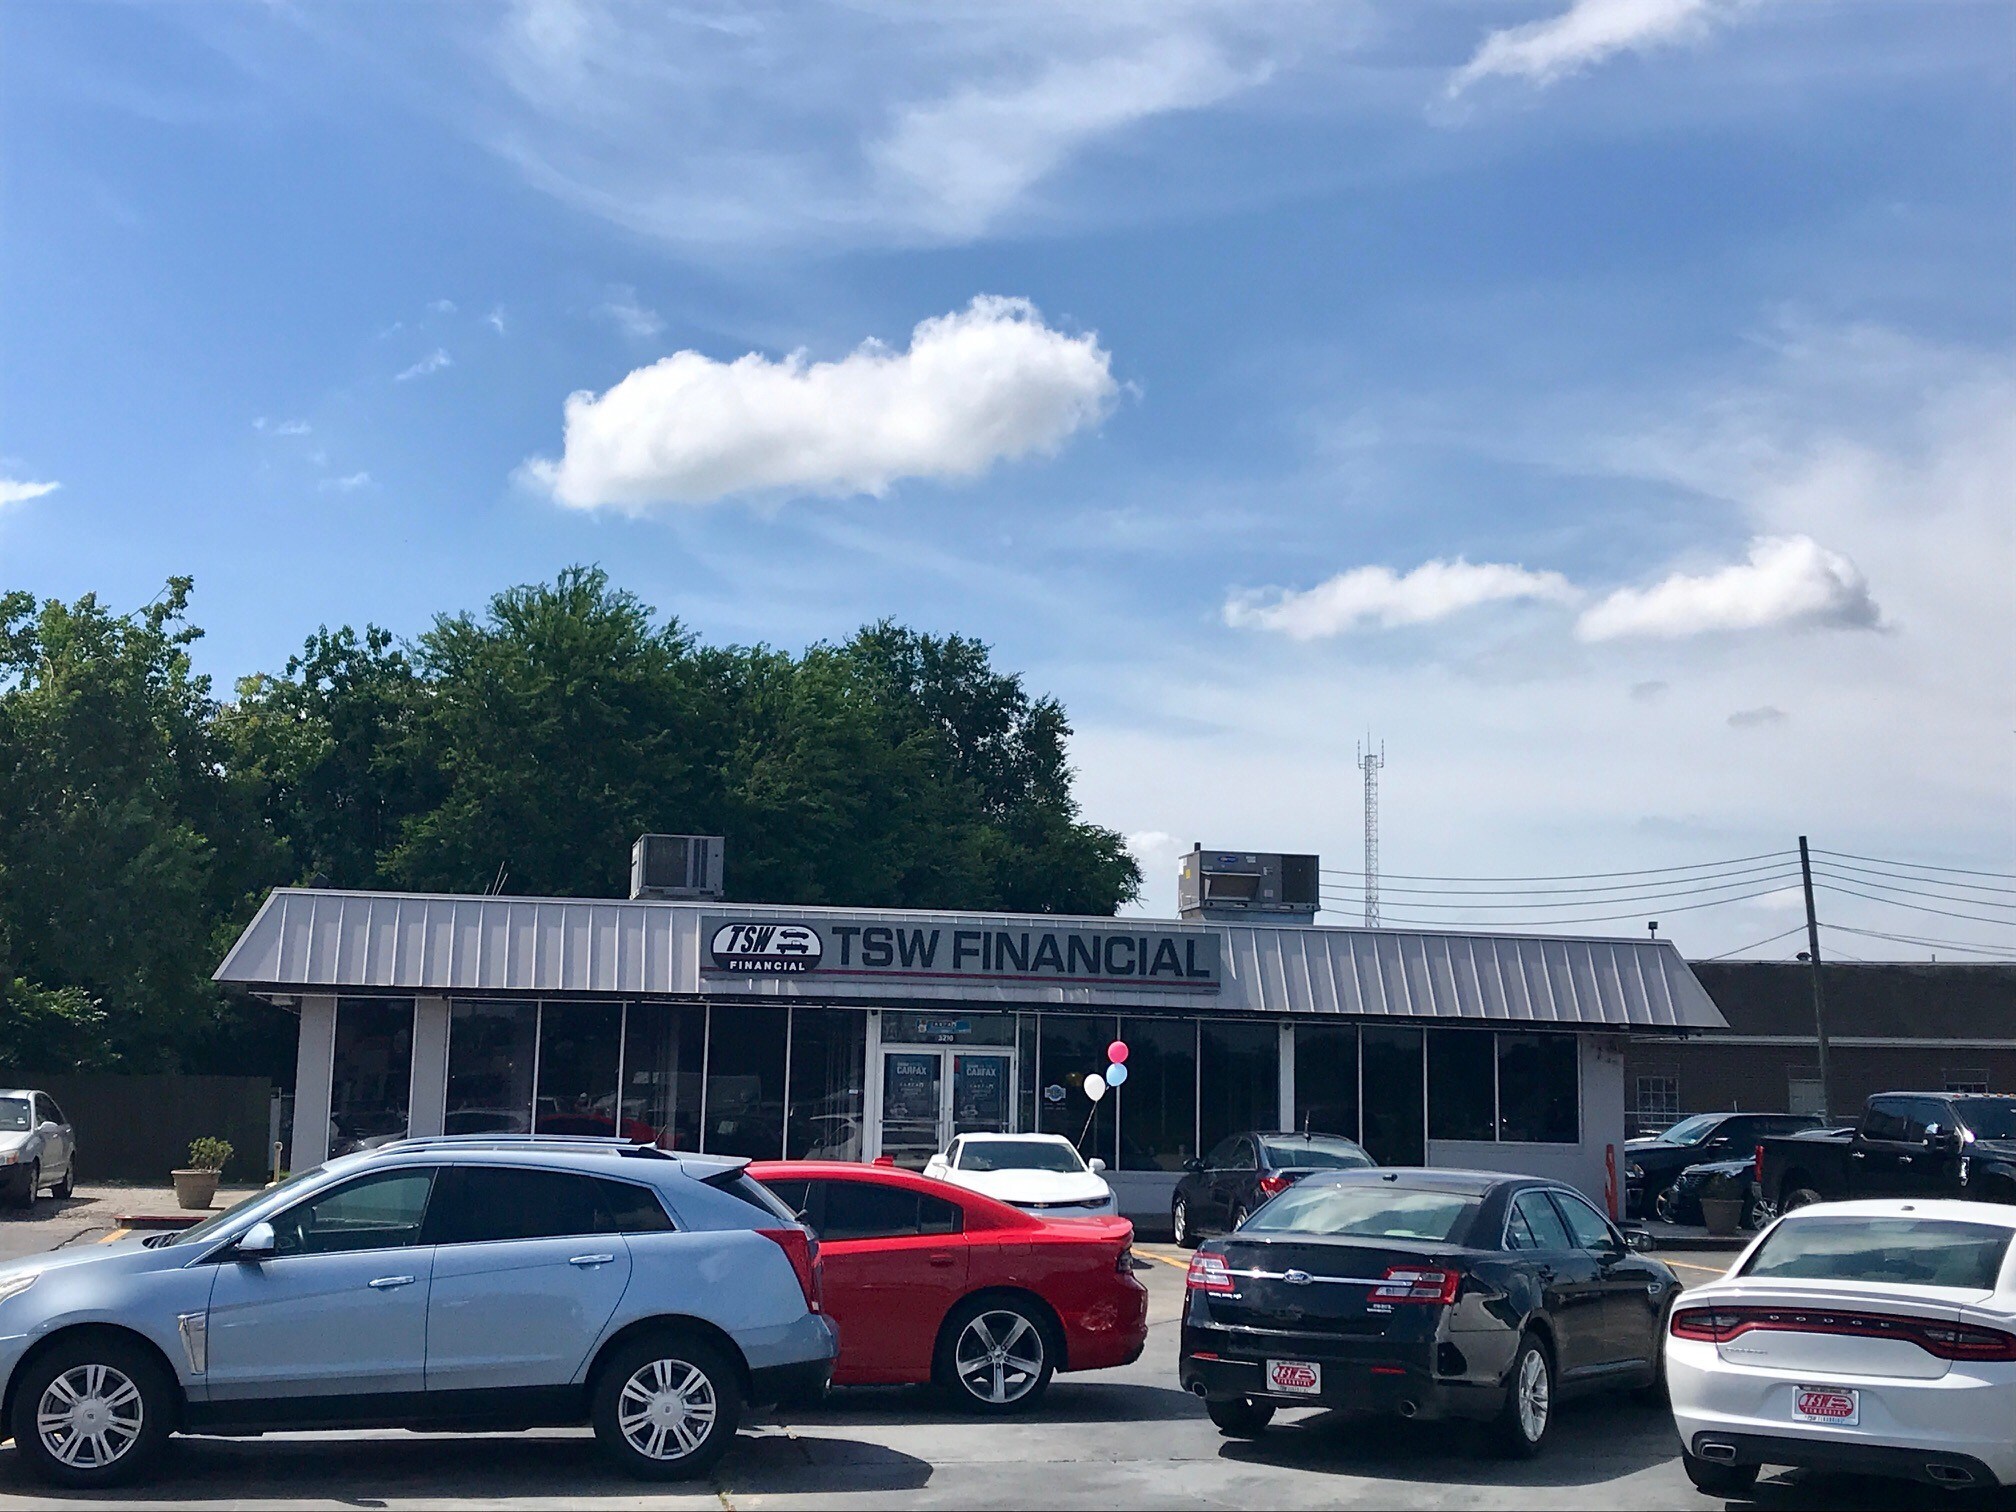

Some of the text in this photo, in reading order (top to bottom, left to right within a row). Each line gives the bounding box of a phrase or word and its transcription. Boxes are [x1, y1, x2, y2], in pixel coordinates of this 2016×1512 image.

[726, 925, 777, 953] TSW
[831, 926, 1210, 978] TSW FINANCIAL
[729, 960, 806, 971] FINANCIAL
